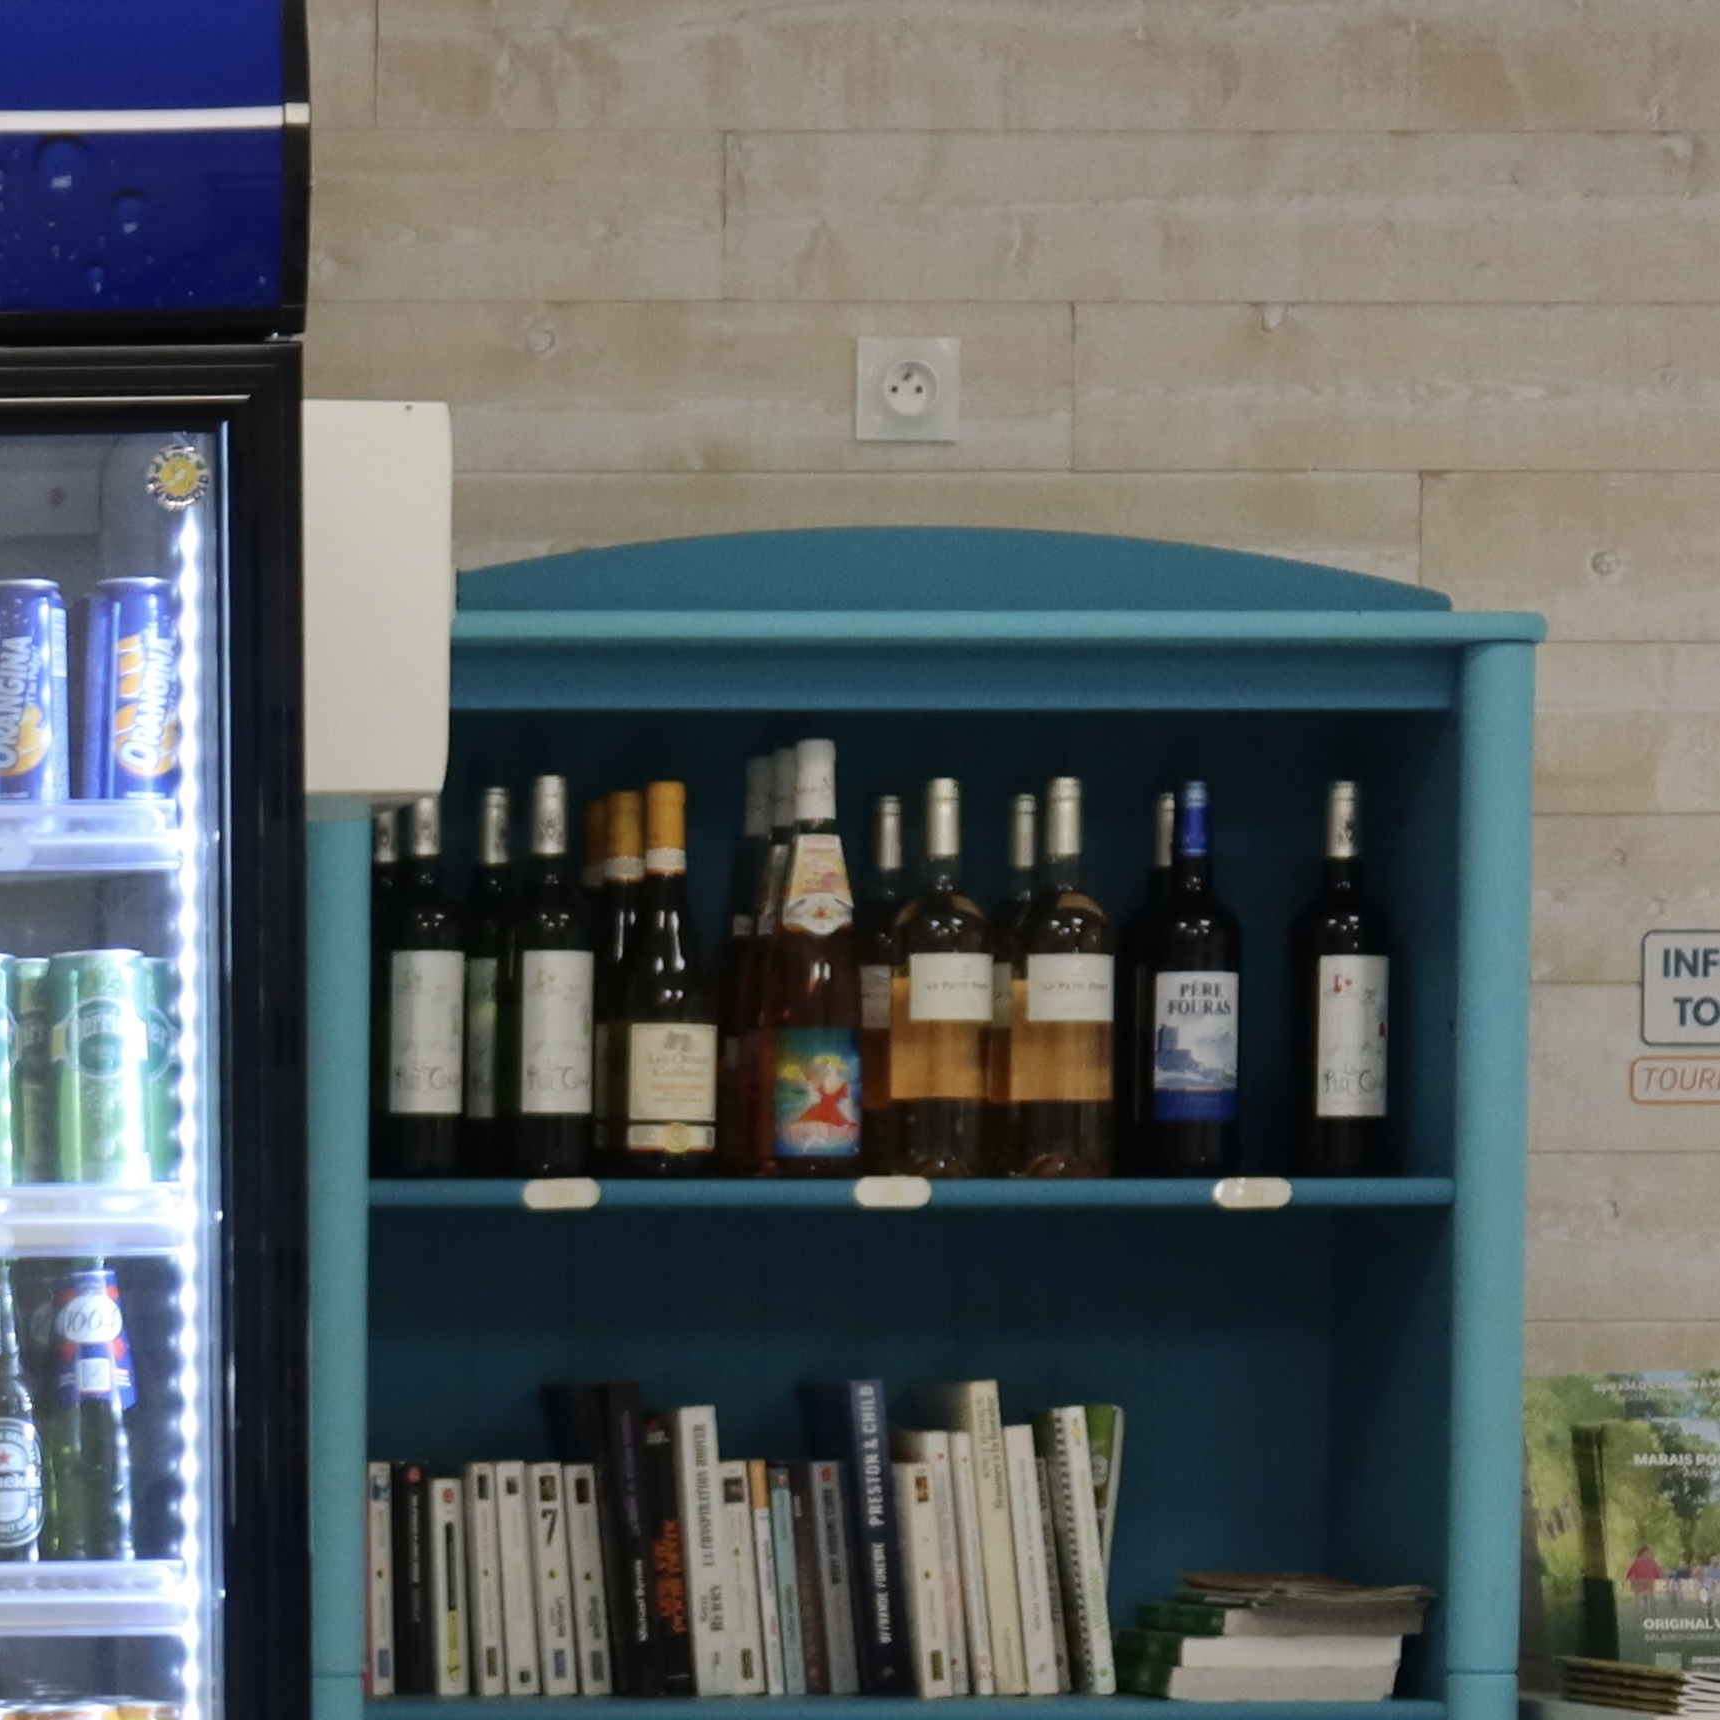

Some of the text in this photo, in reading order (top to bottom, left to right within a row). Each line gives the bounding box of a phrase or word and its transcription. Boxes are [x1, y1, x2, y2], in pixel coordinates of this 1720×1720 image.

[1662, 948, 1720, 979] INF
[1168, 999, 1233, 1016] FOURAS
[1672, 996, 1720, 1028] TO
[1633, 1453, 1693, 1466] MARAIS
[866, 1454, 887, 1527] PRESTON
[1642, 1617, 1713, 1630] ORIGINAL
